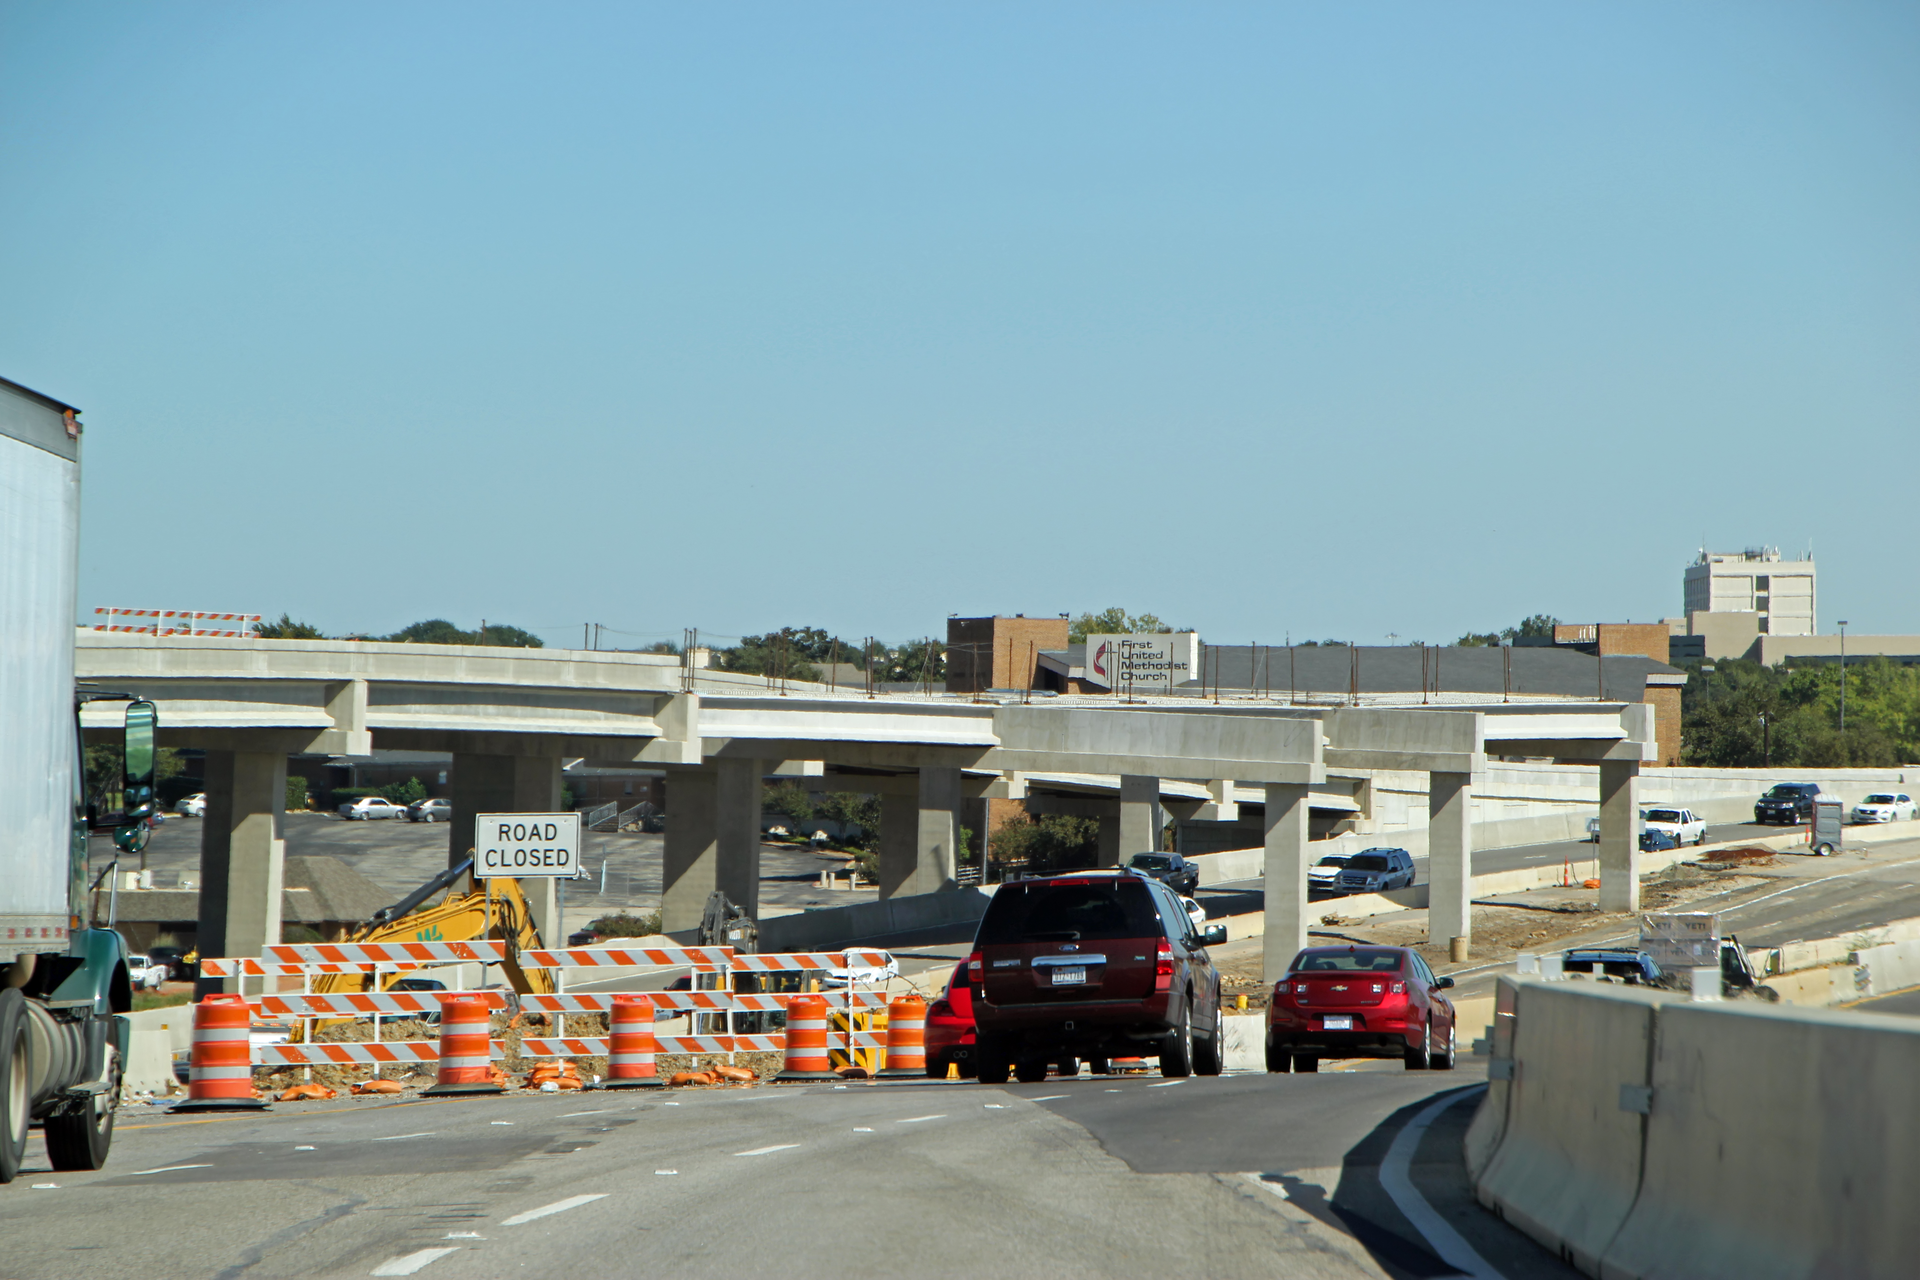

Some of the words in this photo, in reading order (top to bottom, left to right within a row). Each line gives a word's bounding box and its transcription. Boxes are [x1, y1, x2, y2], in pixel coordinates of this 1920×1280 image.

[1121, 640, 1153, 649] First
[1121, 651, 1163, 660] United
[1120, 672, 1168, 681] Church
[498, 823, 557, 842] ROAD
[485, 848, 570, 868] CLOSED
[1685, 922, 1706, 930] YETI
